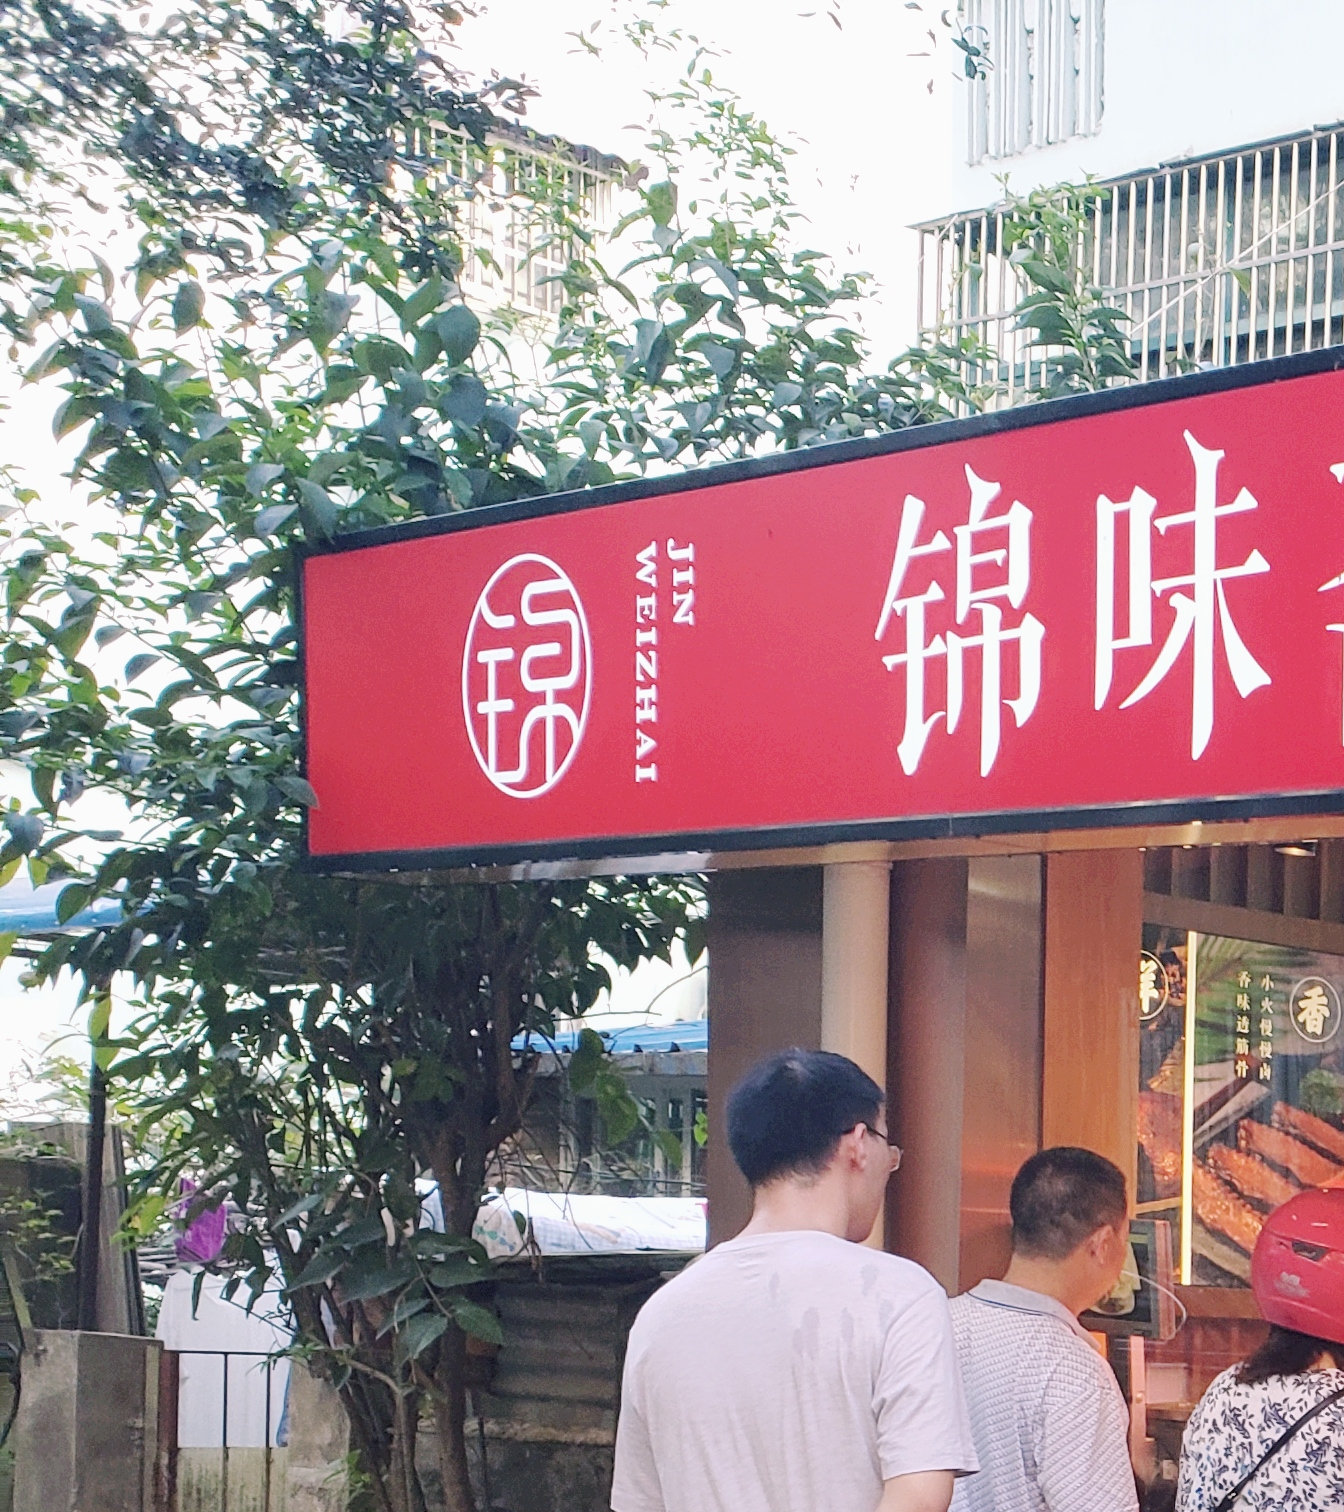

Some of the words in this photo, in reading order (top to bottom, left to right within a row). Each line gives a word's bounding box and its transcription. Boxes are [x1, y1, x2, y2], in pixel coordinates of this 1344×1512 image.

[666, 537, 695, 626] JIN
[634, 540, 658, 783] WEIZHAI
[1296, 985, 1331, 1036] 香
